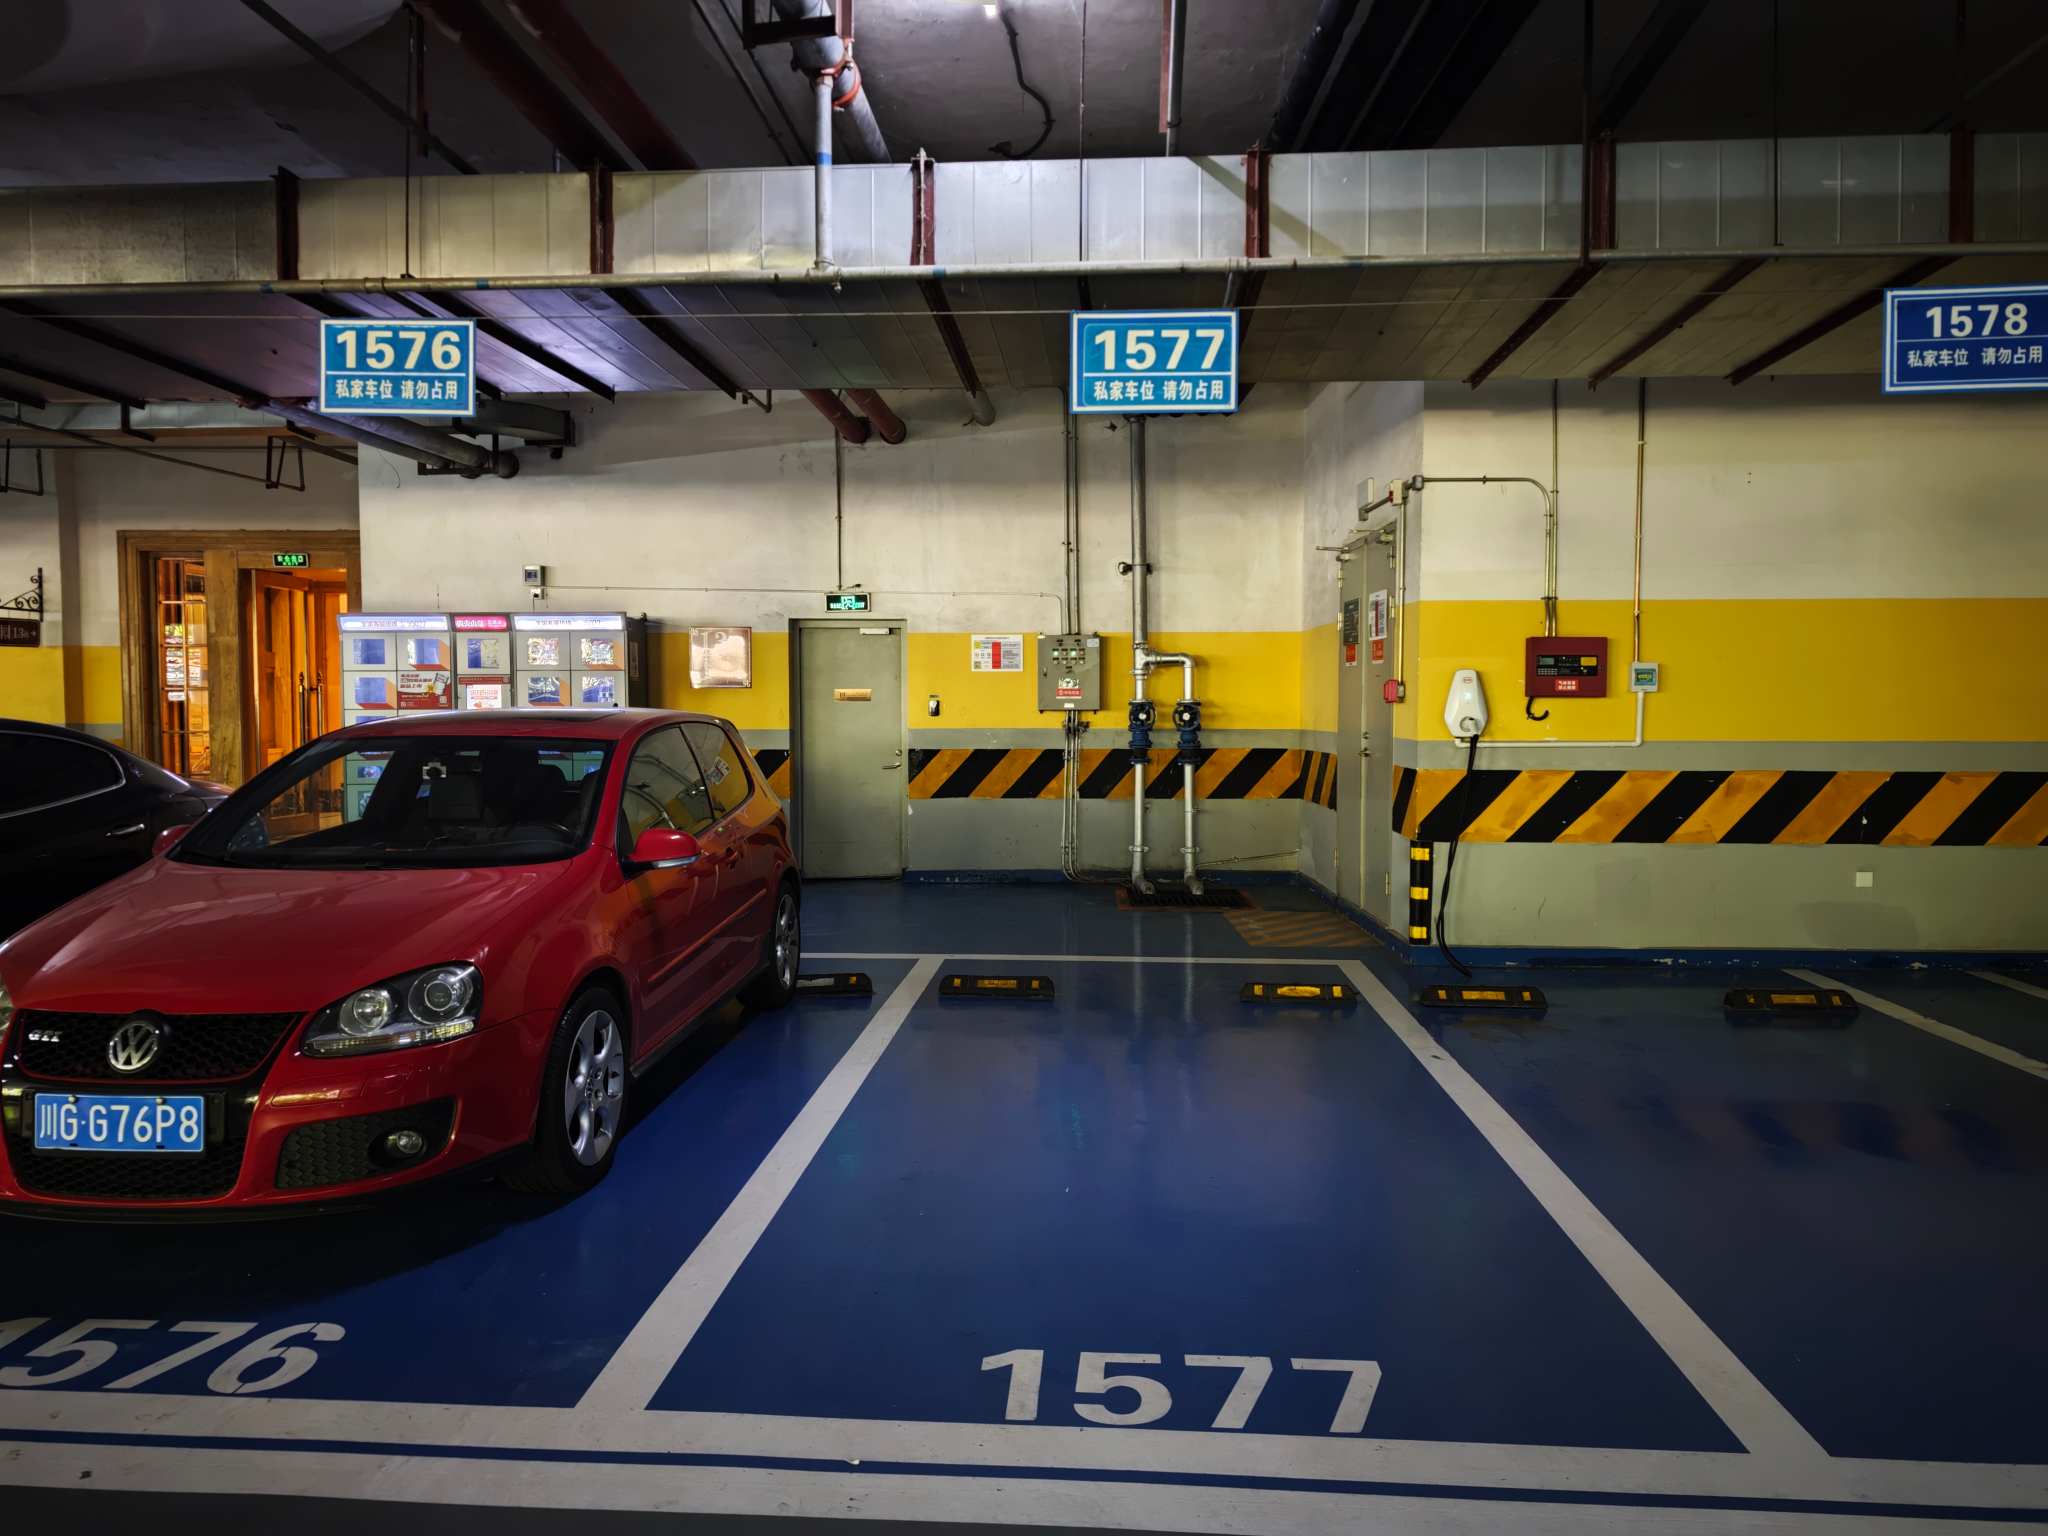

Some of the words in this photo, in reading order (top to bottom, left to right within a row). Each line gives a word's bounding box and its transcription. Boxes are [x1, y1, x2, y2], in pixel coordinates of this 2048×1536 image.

[1926, 303, 2028, 338] 1578
[336, 330, 461, 370] 1576
[1094, 329, 1225, 370] 1577
[1907, 348, 1969, 368] 私家车位
[1981, 345, 2043, 365] 请勿占用
[335, 379, 393, 399] 私家车位
[401, 380, 458, 400] 请勿占用
[1094, 380, 1154, 401] 私家车位
[1163, 379, 1224, 400] 请勿占用
[39, 1103, 199, 1144] 川G·G76P8
[981, 1348, 1382, 1433] 1577
